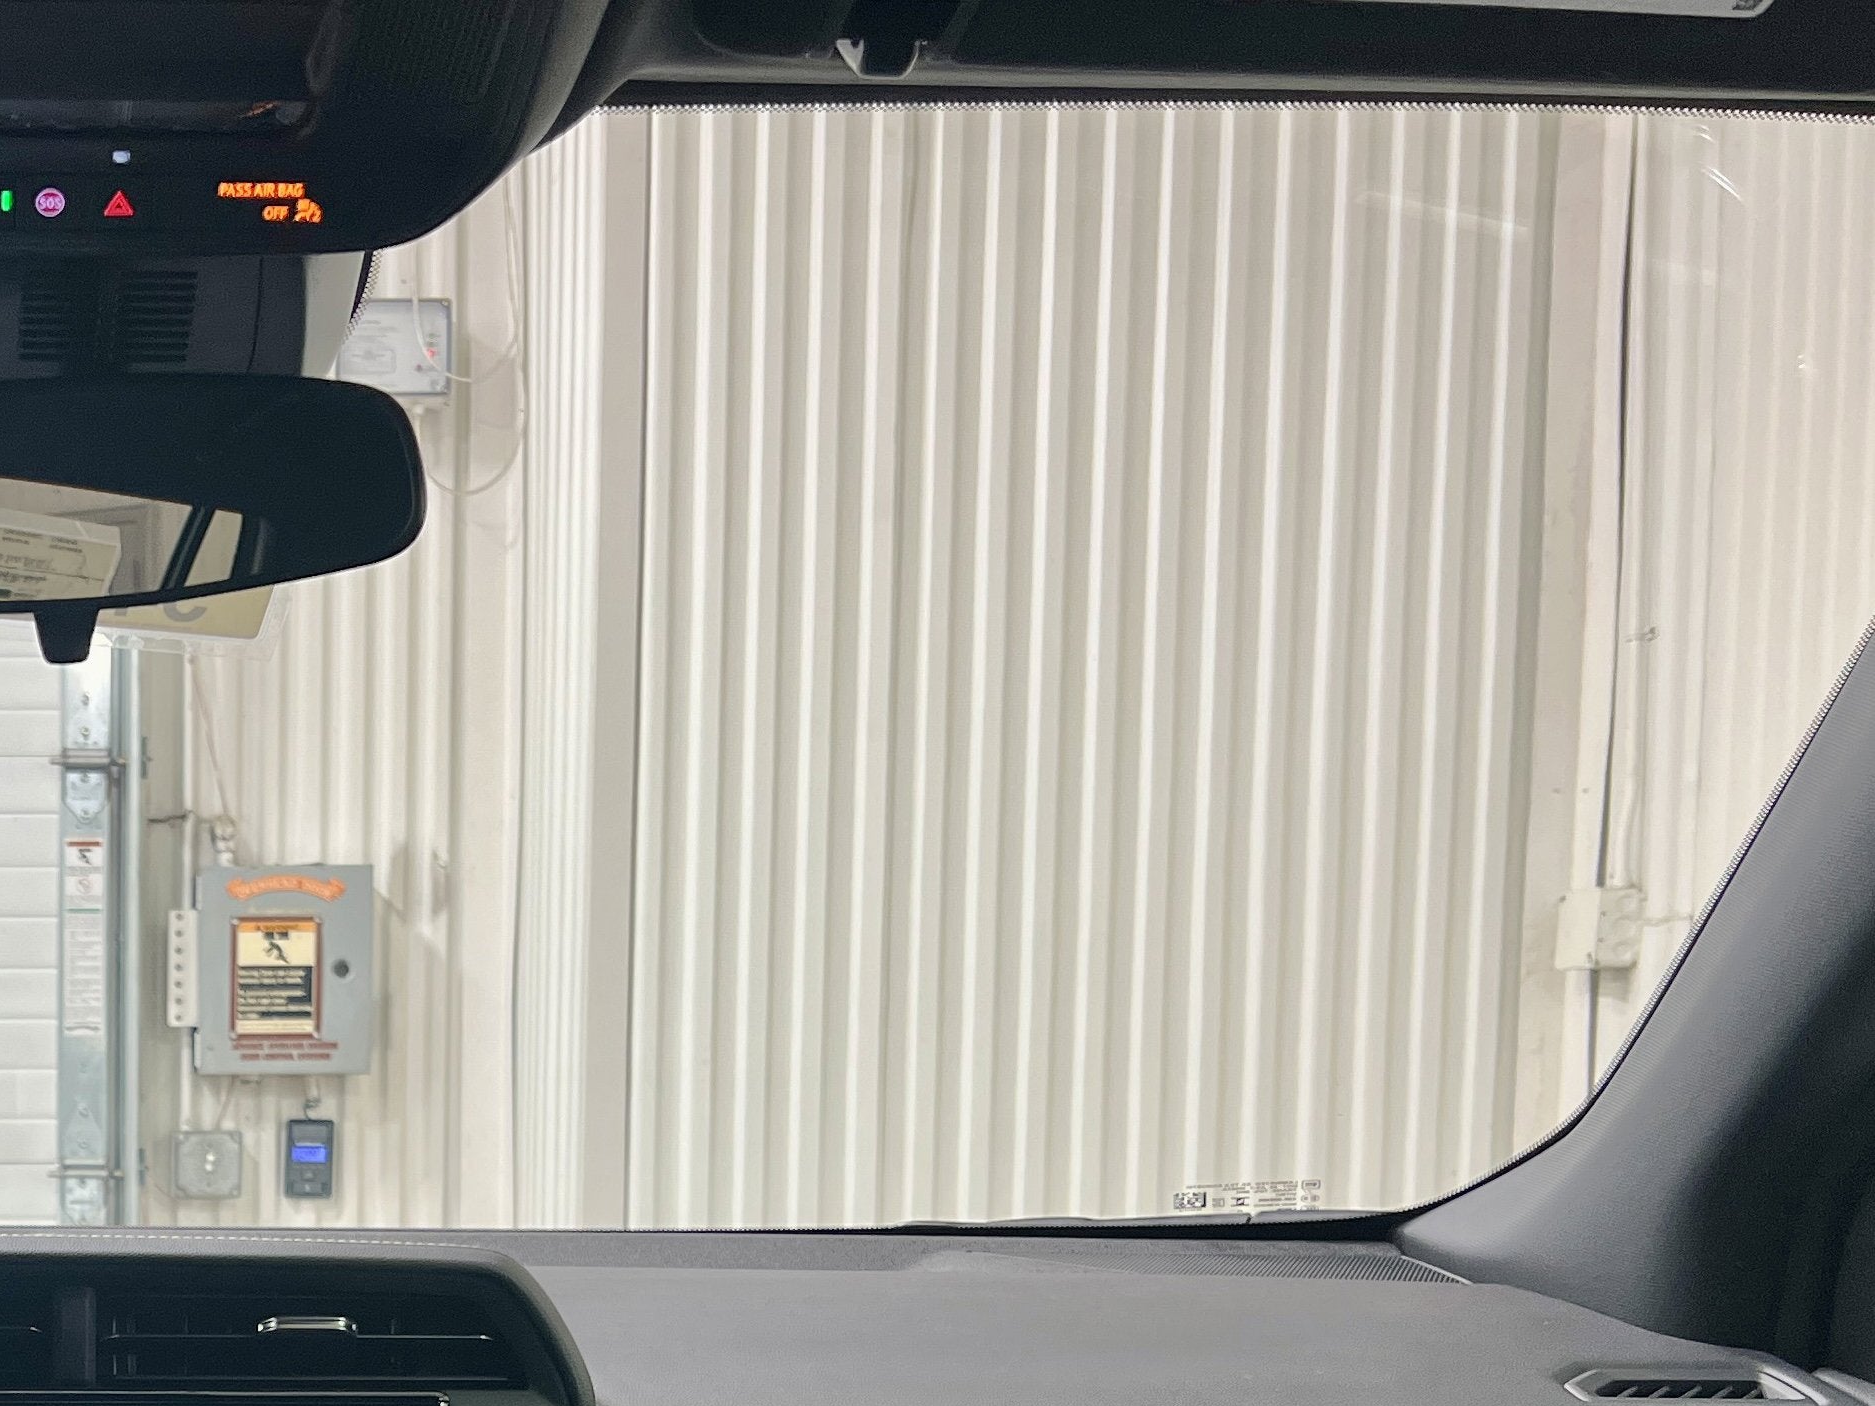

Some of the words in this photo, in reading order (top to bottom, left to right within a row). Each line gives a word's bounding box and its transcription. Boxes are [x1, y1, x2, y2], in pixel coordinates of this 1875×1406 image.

[218, 182, 253, 197] PASS
[254, 182, 275, 197] AIR
[277, 182, 305, 198] BAG
[39, 197, 62, 209] SOS
[263, 206, 289, 221] OFF
